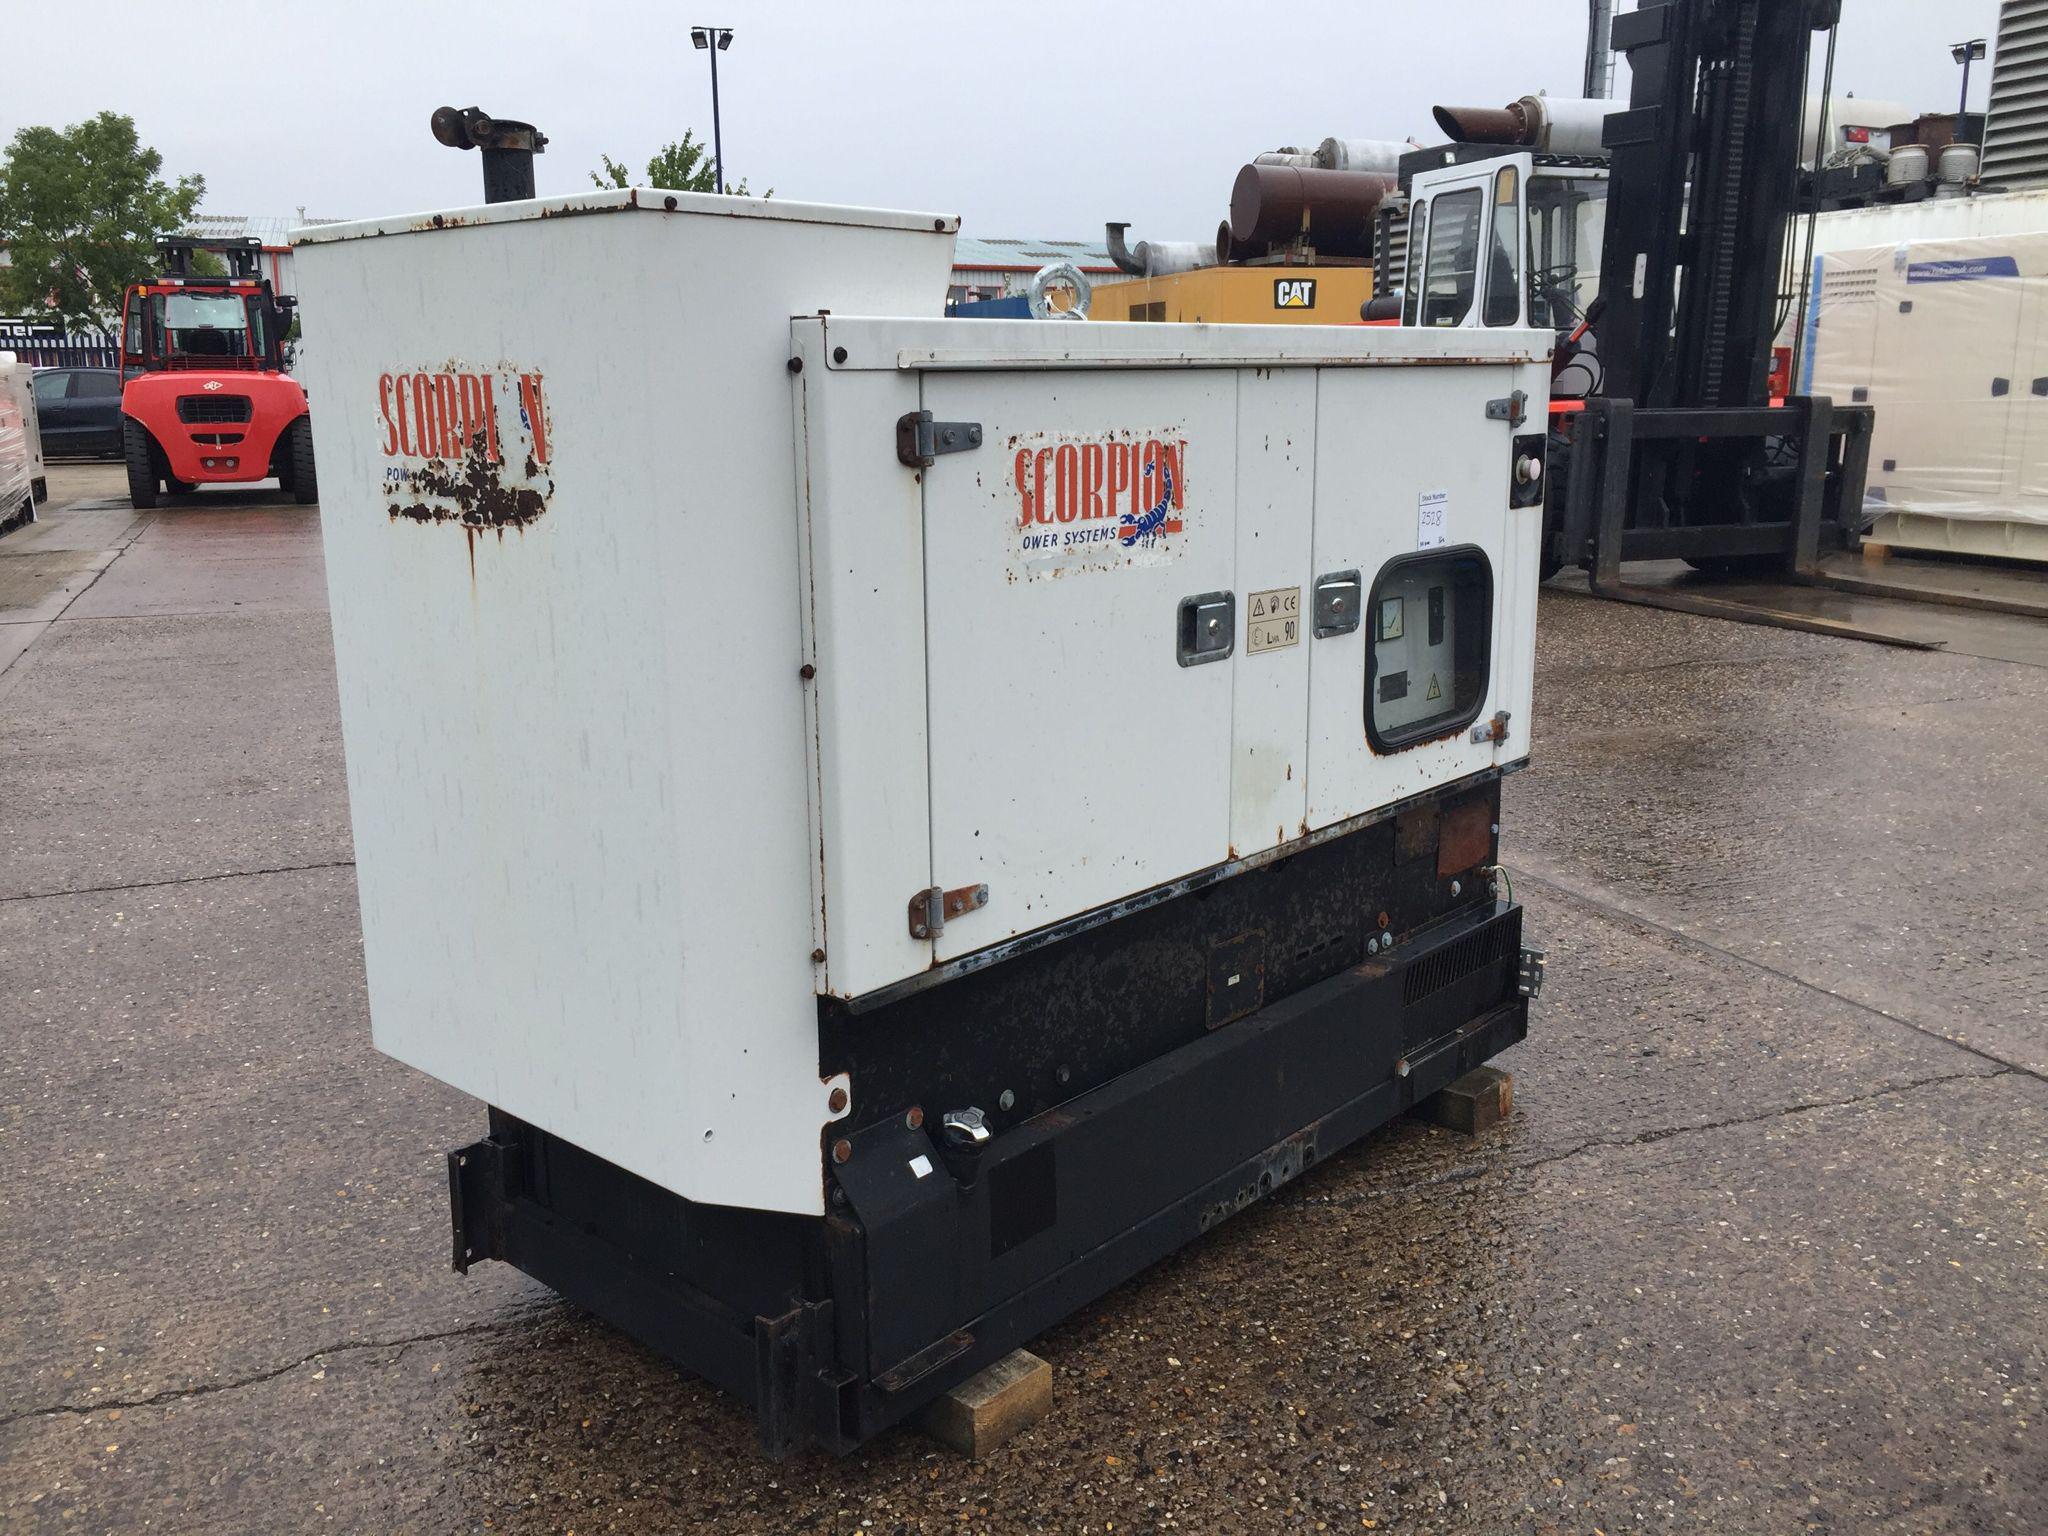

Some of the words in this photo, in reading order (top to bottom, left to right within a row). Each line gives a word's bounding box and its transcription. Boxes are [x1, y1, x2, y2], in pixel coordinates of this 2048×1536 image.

[1277, 281, 1312, 306] CAT
[379, 373, 547, 464] SCORPIN
[1015, 439, 1189, 527] SCORPION
[1421, 510, 1442, 526] 2528
[1064, 527, 1117, 546] SYSTEMS
[1284, 620, 1295, 641] 90
